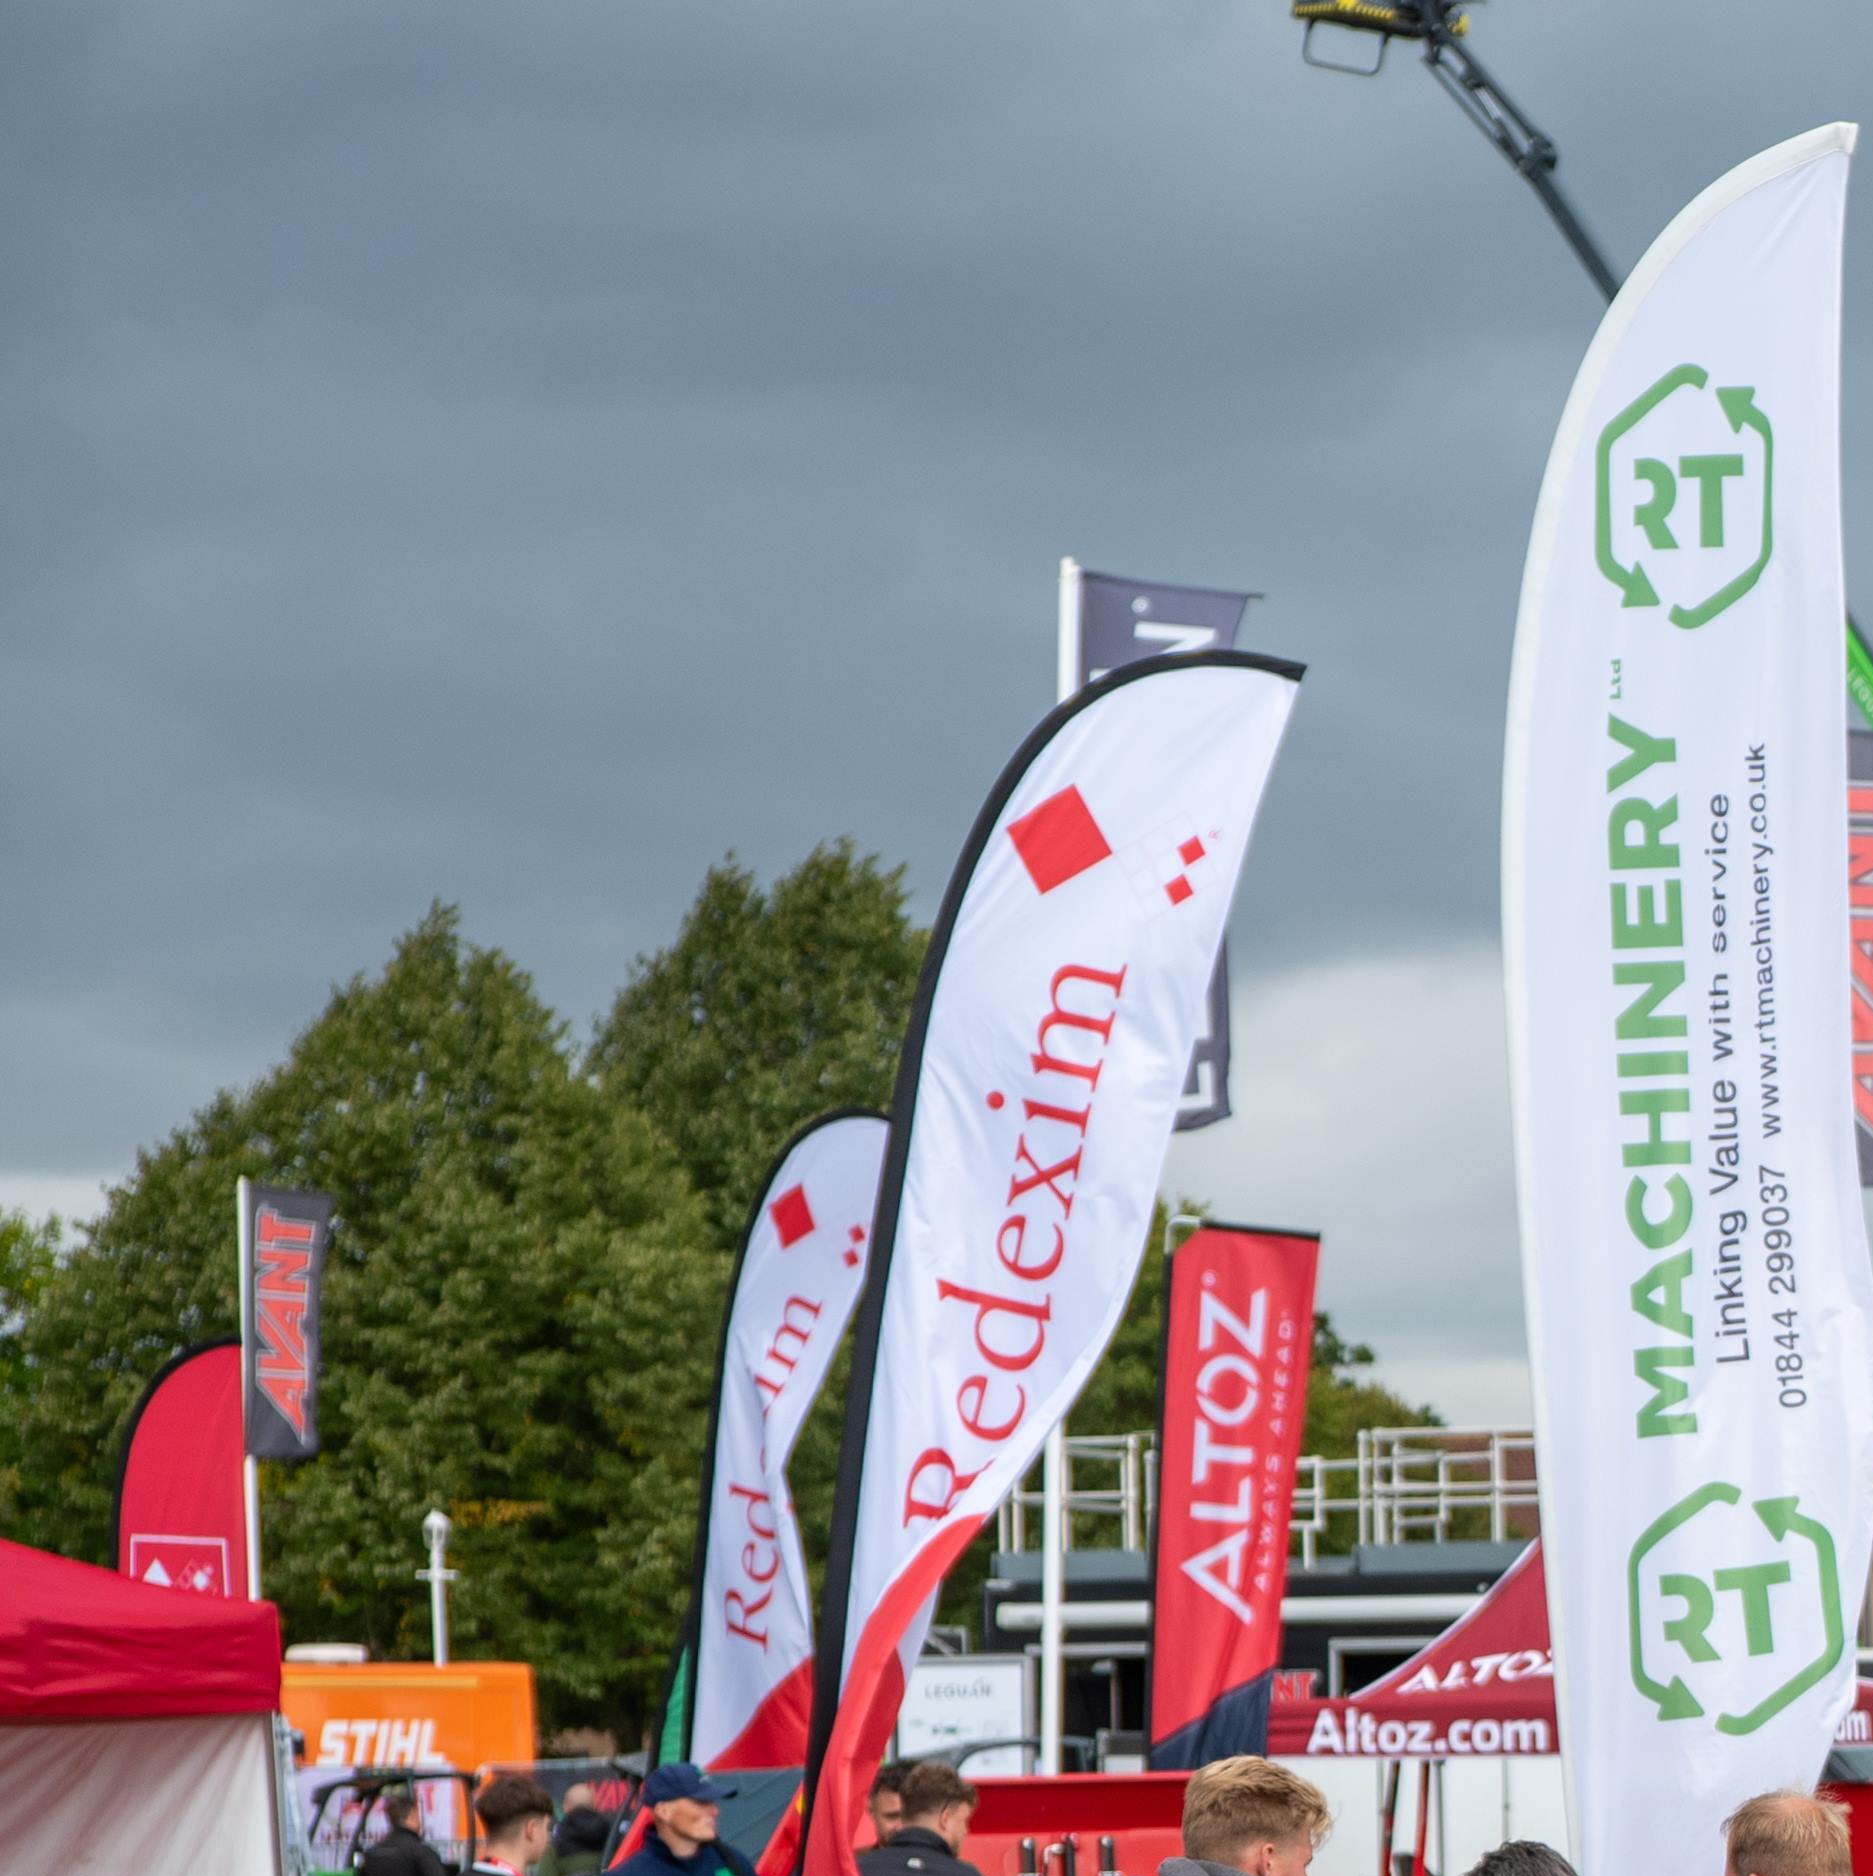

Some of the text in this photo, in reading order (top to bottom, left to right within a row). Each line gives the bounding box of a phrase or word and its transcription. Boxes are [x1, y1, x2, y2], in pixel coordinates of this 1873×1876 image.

[1632, 453, 1744, 550] RT
[1606, 657, 1699, 1440] MACHINERY Ltd
[1705, 792, 1752, 1365] Linking Value with service
[1745, 742, 1808, 1410] 01844 299037 www.rtmachinery.co.uk
[255, 1203, 323, 1447] AVANT
[903, 963, 1129, 1530] Redexim
[1181, 1286, 1268, 1625] ALTOZ
[1252, 1316, 1296, 1595] ALWAYS AHEAD
[316, 1718, 445, 1767] STIHL
[1306, 1707, 1548, 1756] Altoz.com
[1659, 1560, 1791, 1663] RT
